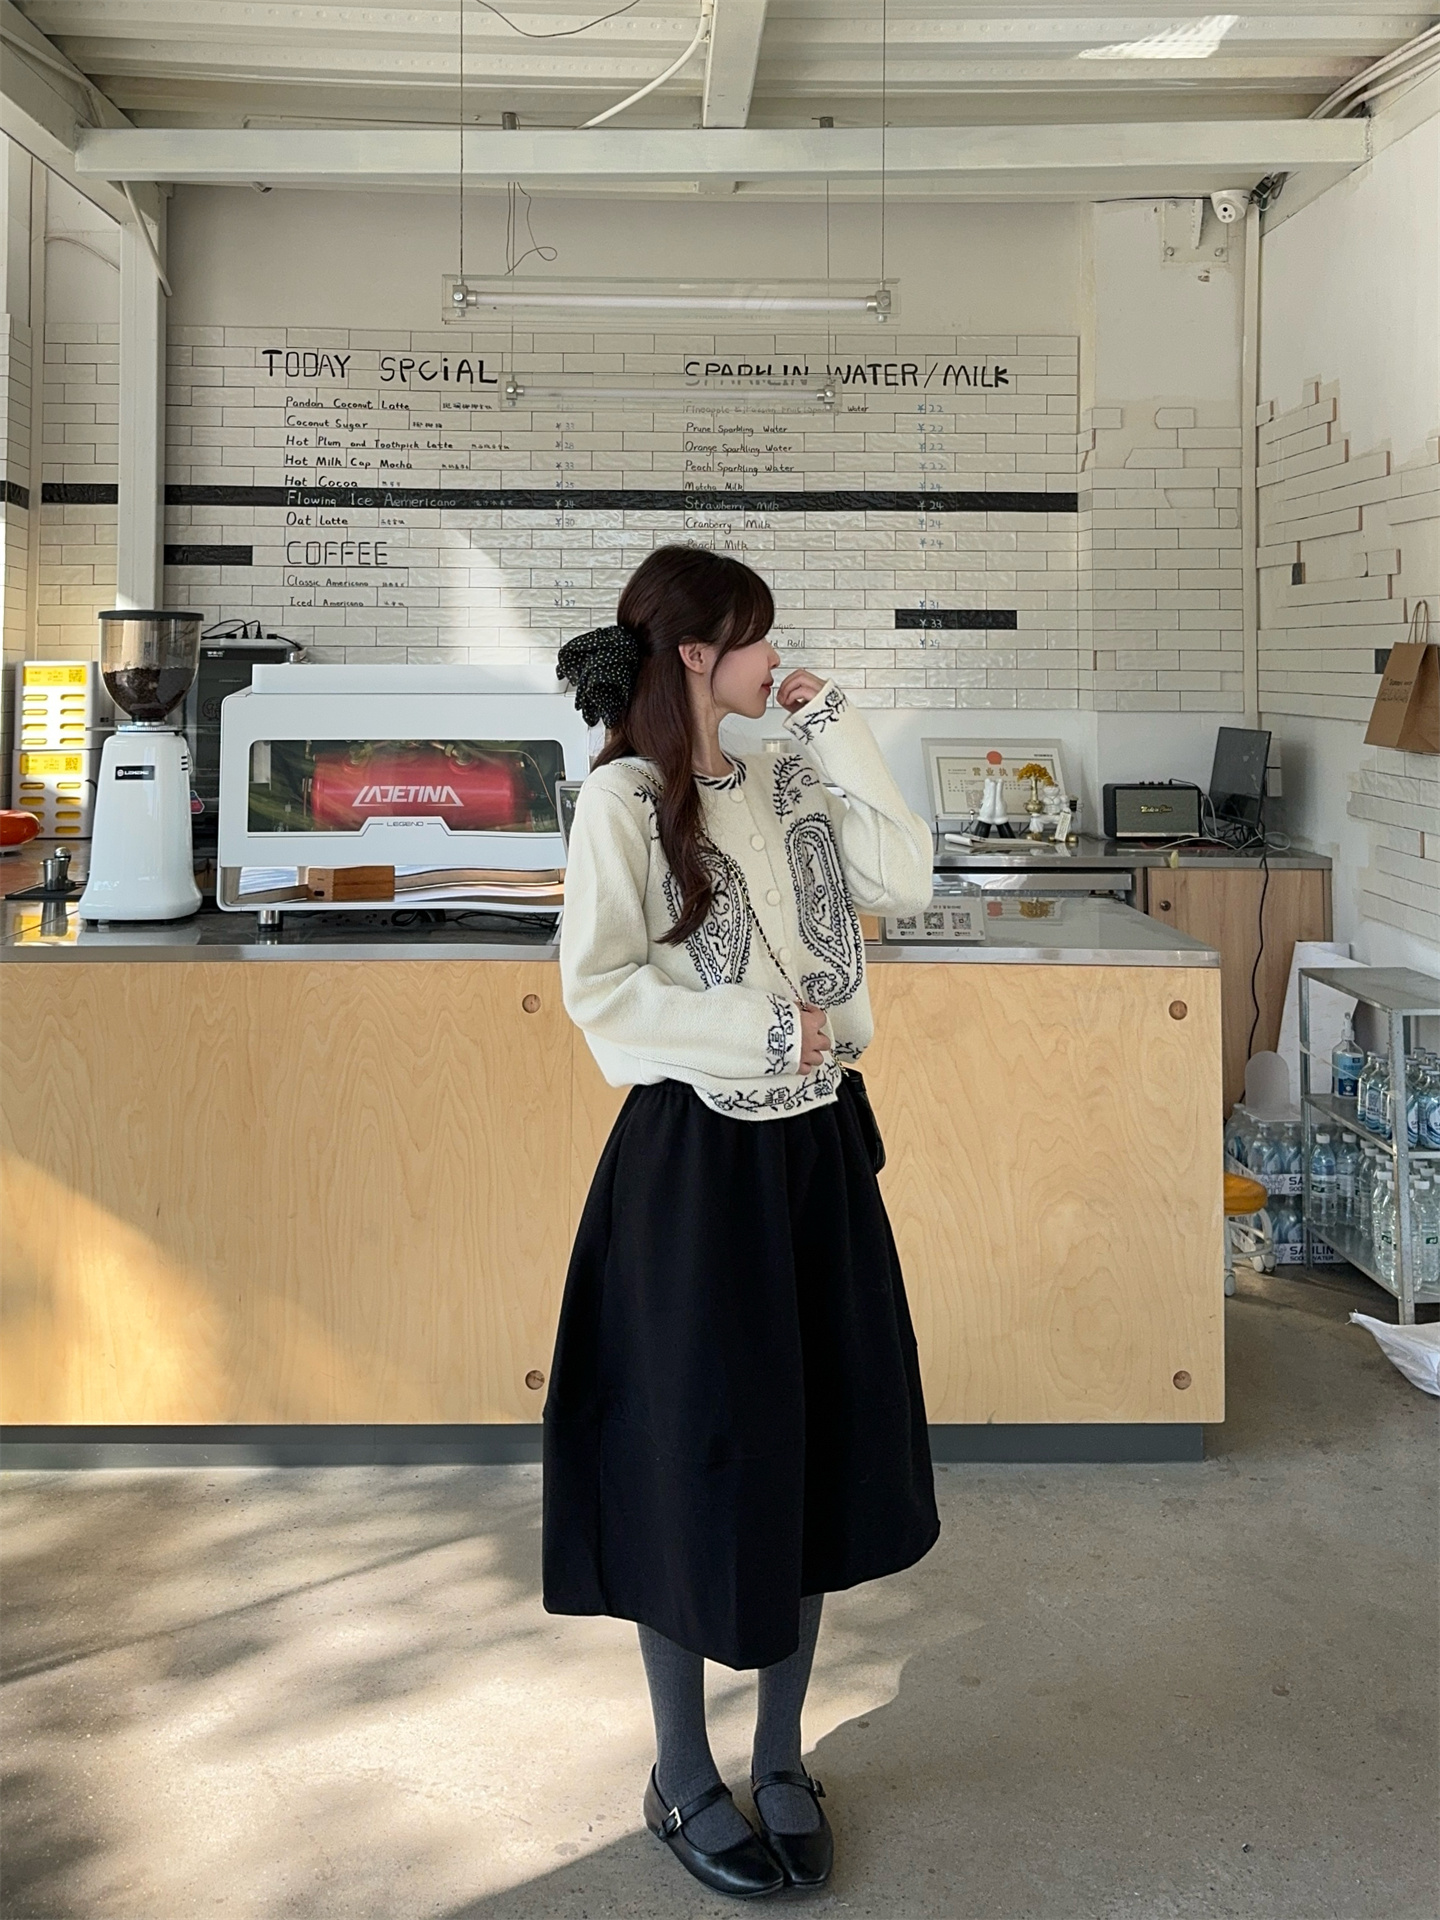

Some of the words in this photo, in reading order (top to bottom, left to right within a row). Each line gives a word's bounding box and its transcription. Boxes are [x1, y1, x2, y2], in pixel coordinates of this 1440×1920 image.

[262, 349, 351, 379] TODAY
[286, 396, 324, 409] Pandan
[333, 398, 374, 410] Coconut
[381, 400, 411, 411] Latte
[286, 415, 330, 428] Coconut
[335, 418, 369, 433] Sugar
[686, 421, 711, 433] Prune
[717, 424, 754, 437] Sparkling
[286, 435, 310, 447] Hot
[317, 436, 342, 448] Plum
[350, 440, 367, 448] and
[374, 439, 420, 452] Toothpick
[685, 440, 718, 457] Orange
[722, 443, 761, 459] Sparkling
[765, 444, 793, 452] Water
[284, 454, 309, 466] Hot
[315, 455, 343, 467] Milk
[350, 457, 372, 470] Cap
[379, 459, 413, 469] Mocha
[686, 459, 712, 473] Peach
[717, 462, 759, 477] Sparkling
[764, 464, 795, 473] Water
[284, 474, 308, 488] Hot
[317, 475, 359, 488] Cocoa
[725, 481, 744, 491] Milk
[286, 490, 337, 508] Flowing
[350, 492, 374, 507] Ice
[684, 495, 746, 512] Strawberry
[756, 500, 780, 512] Milk
[285, 511, 312, 527] Oat
[685, 516, 732, 535] Cranberry
[745, 519, 772, 530] Milk
[286, 540, 389, 566] COFFEE
[724, 540, 750, 551] Milk
[286, 574, 320, 588] Classic
[325, 577, 369, 588] Americano
[289, 596, 313, 607] Iced
[322, 599, 365, 608] Americano
